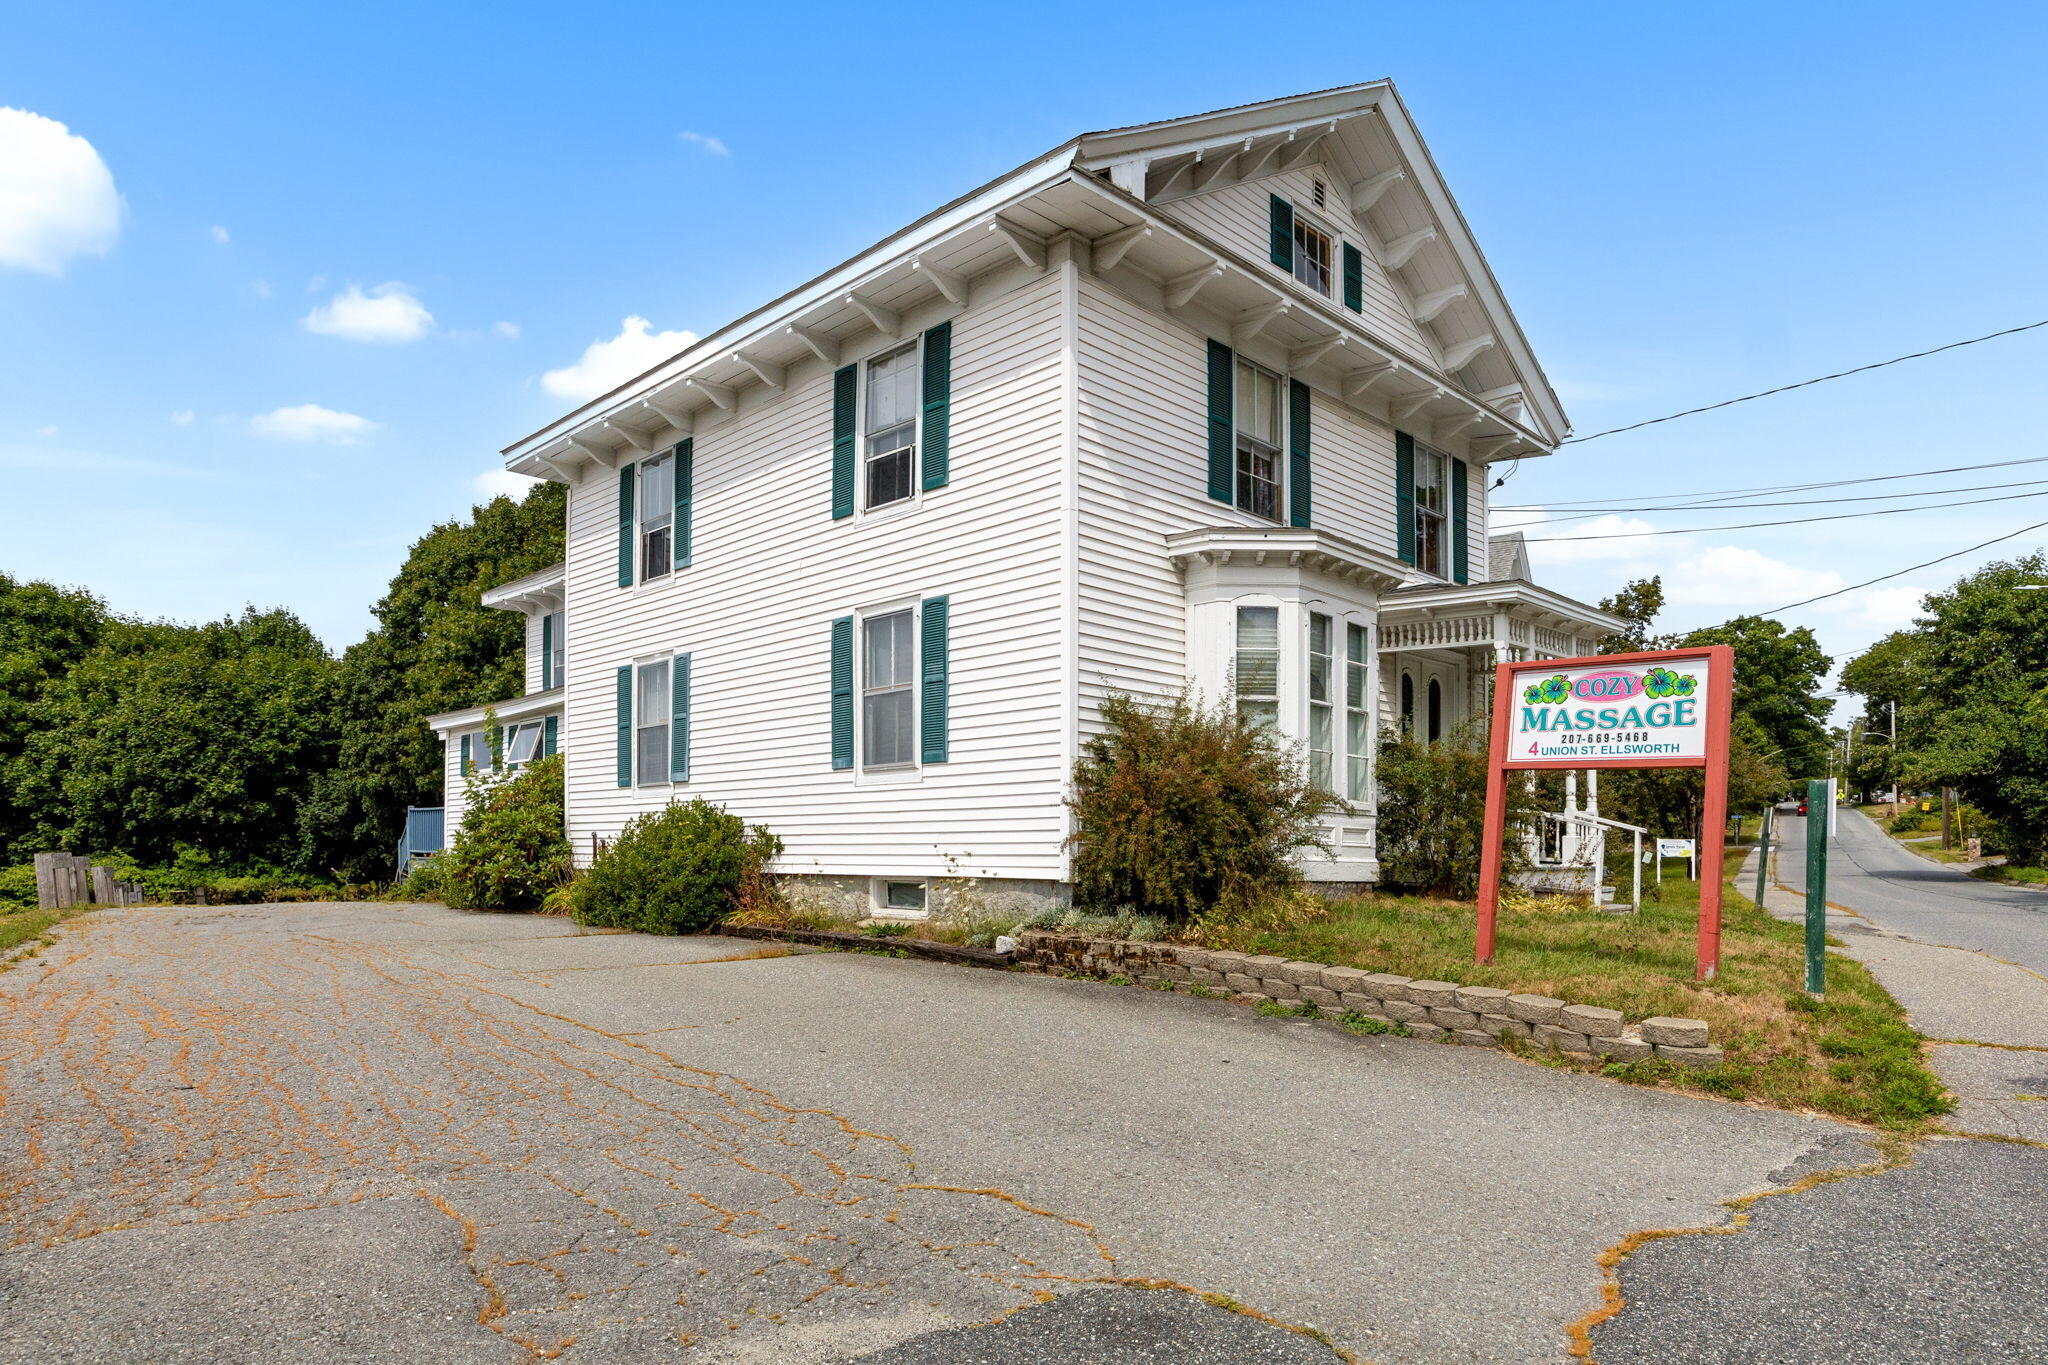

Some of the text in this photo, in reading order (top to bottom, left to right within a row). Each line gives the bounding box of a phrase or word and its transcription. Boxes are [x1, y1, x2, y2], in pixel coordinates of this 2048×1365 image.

[1575, 676, 1637, 697] COZY
[1520, 698, 1697, 732] MASSAGE
[1561, 732, 1648, 744] 207-669-5468
[1528, 741, 1680, 756] 4 UNION ST. ELLSWORTH
